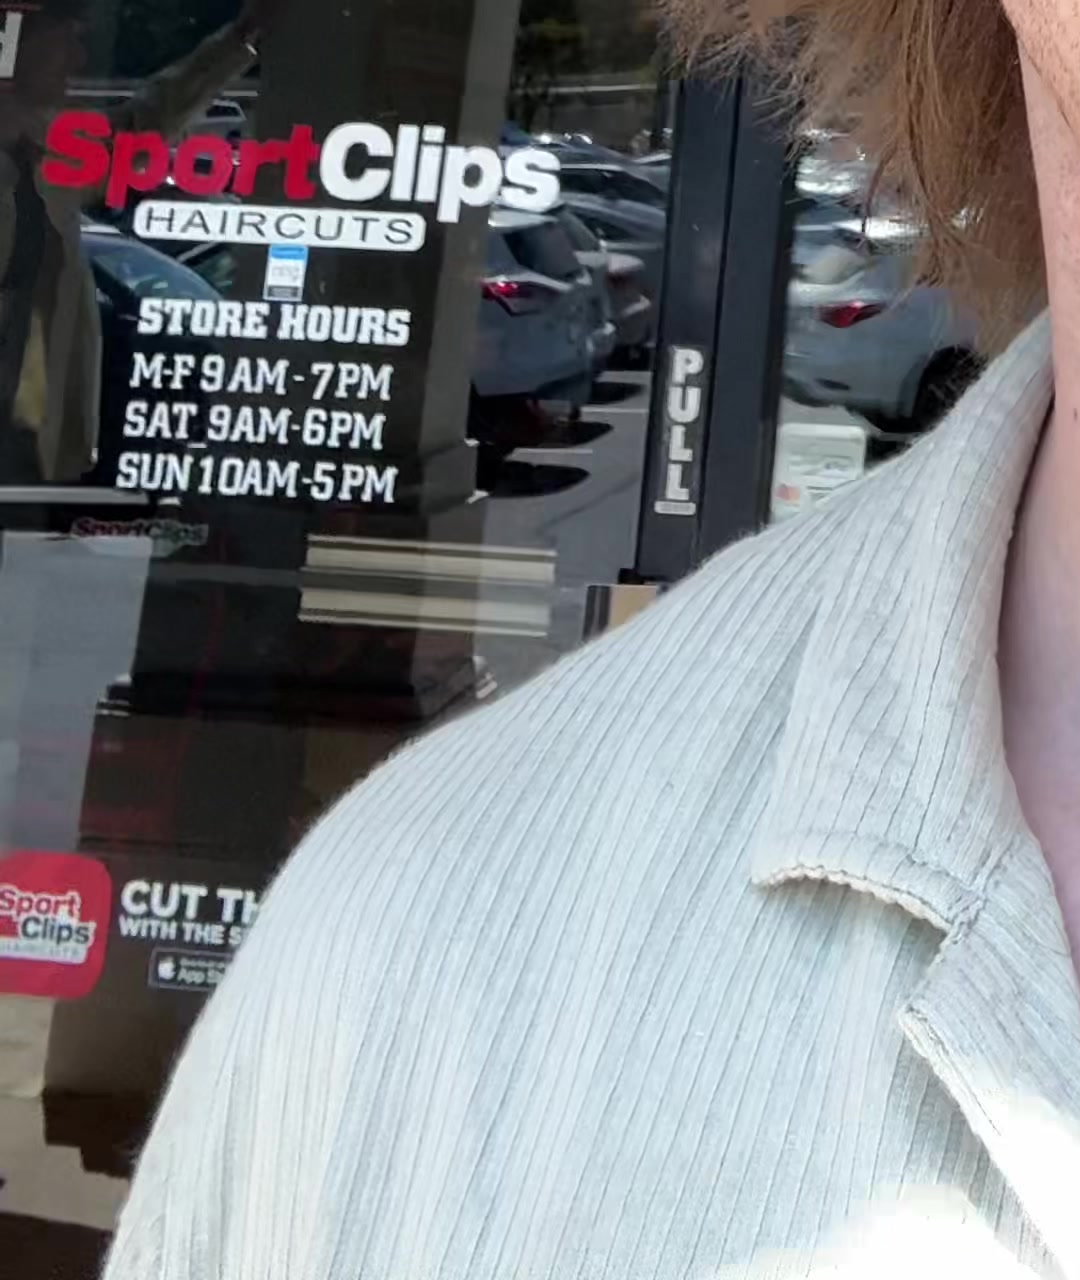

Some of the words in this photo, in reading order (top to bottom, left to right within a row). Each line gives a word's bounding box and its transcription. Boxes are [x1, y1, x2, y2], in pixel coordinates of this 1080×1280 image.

[145, 206, 414, 246] HAIRCUTS
[137, 297, 270, 339] STORE
[277, 303, 412, 346] HOURS
[128, 351, 196, 390] M-F
[122, 400, 198, 439] SAT
[665, 347, 704, 500] PULL
[115, 451, 194, 491] SUN
[0, 889, 80, 918] Sport
[121, 880, 208, 920] CUT
[217, 887, 260, 924] TH
[21, 916, 90, 945] Clips
[119, 914, 178, 941] WITH
[182, 922, 225, 945] THE
